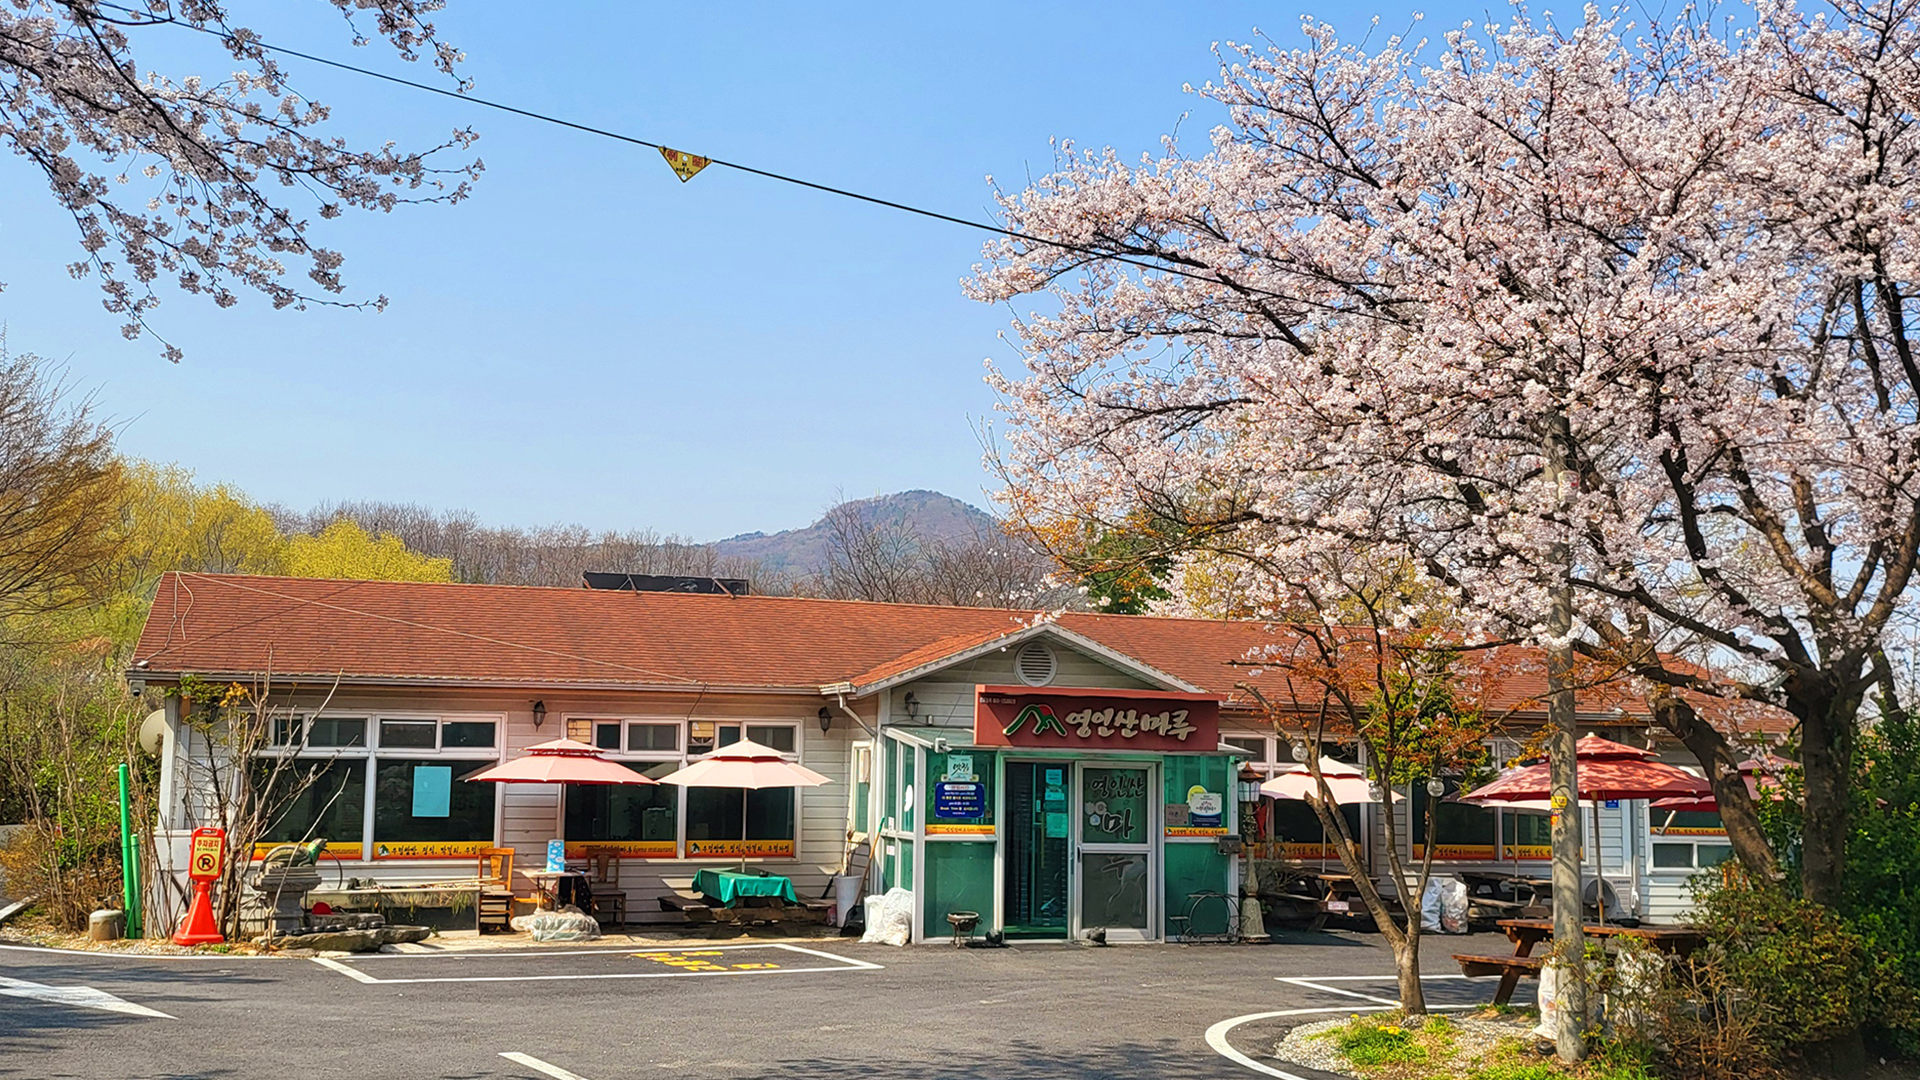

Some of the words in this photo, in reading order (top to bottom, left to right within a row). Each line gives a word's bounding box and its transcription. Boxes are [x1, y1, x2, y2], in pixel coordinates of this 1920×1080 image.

[1065, 707, 1198, 742] 영인산마루
[1091, 775, 1145, 798] 영인산
[197, 839, 219, 848] 주차금지
